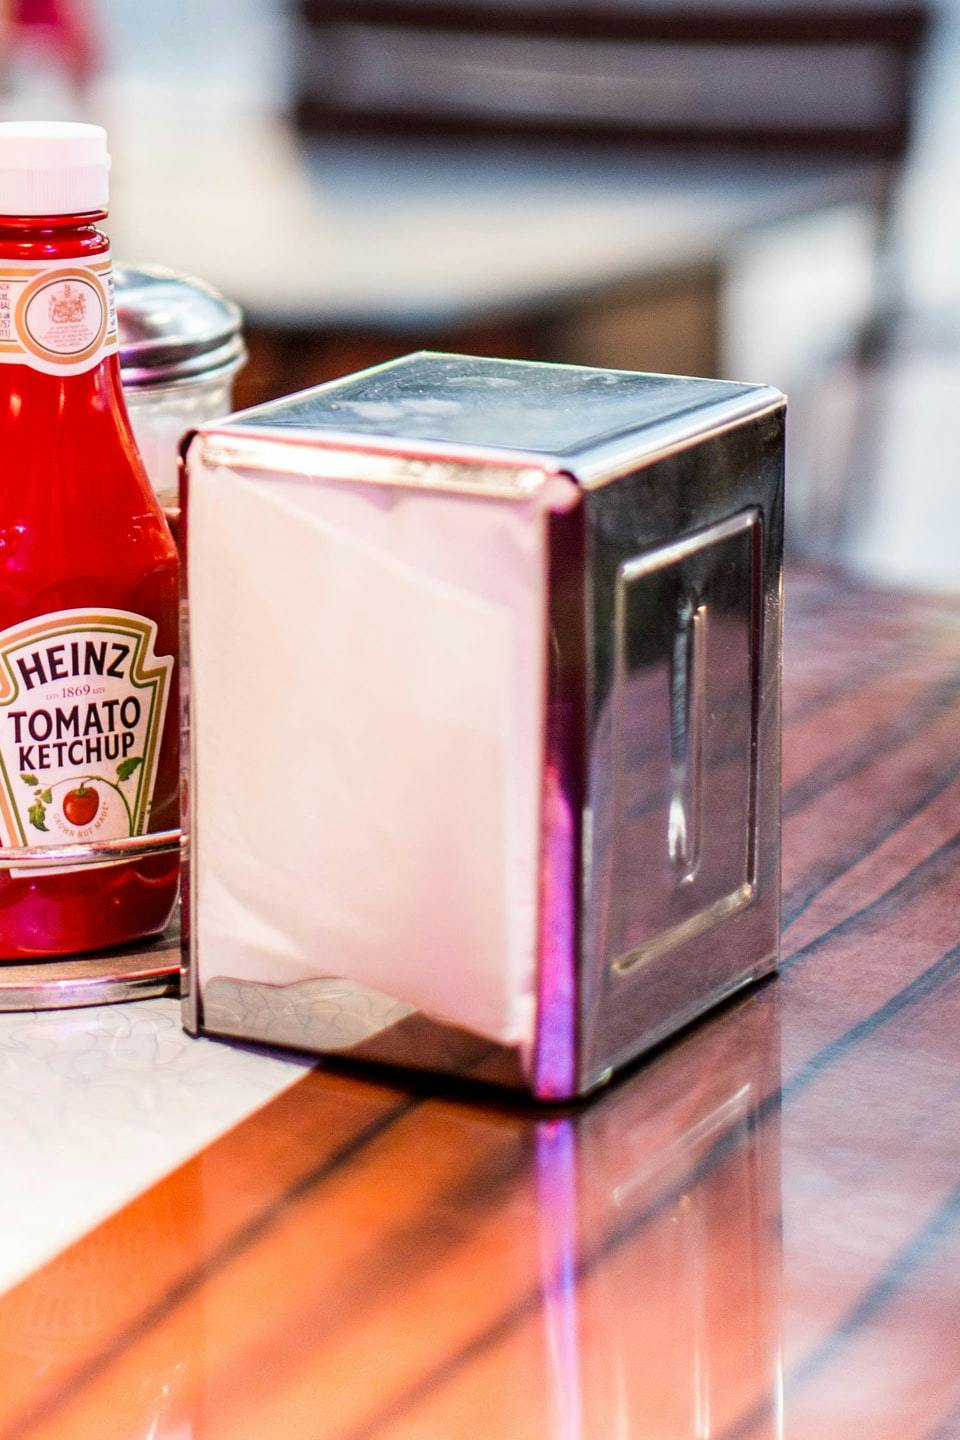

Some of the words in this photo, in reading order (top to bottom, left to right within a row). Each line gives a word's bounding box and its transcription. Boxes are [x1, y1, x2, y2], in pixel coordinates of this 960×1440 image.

[16, 640, 130, 690] HEINZ
[61, 684, 91, 699] 1869
[7, 695, 141, 744] TOMATO
[19, 731, 135, 771] KETCHUP
